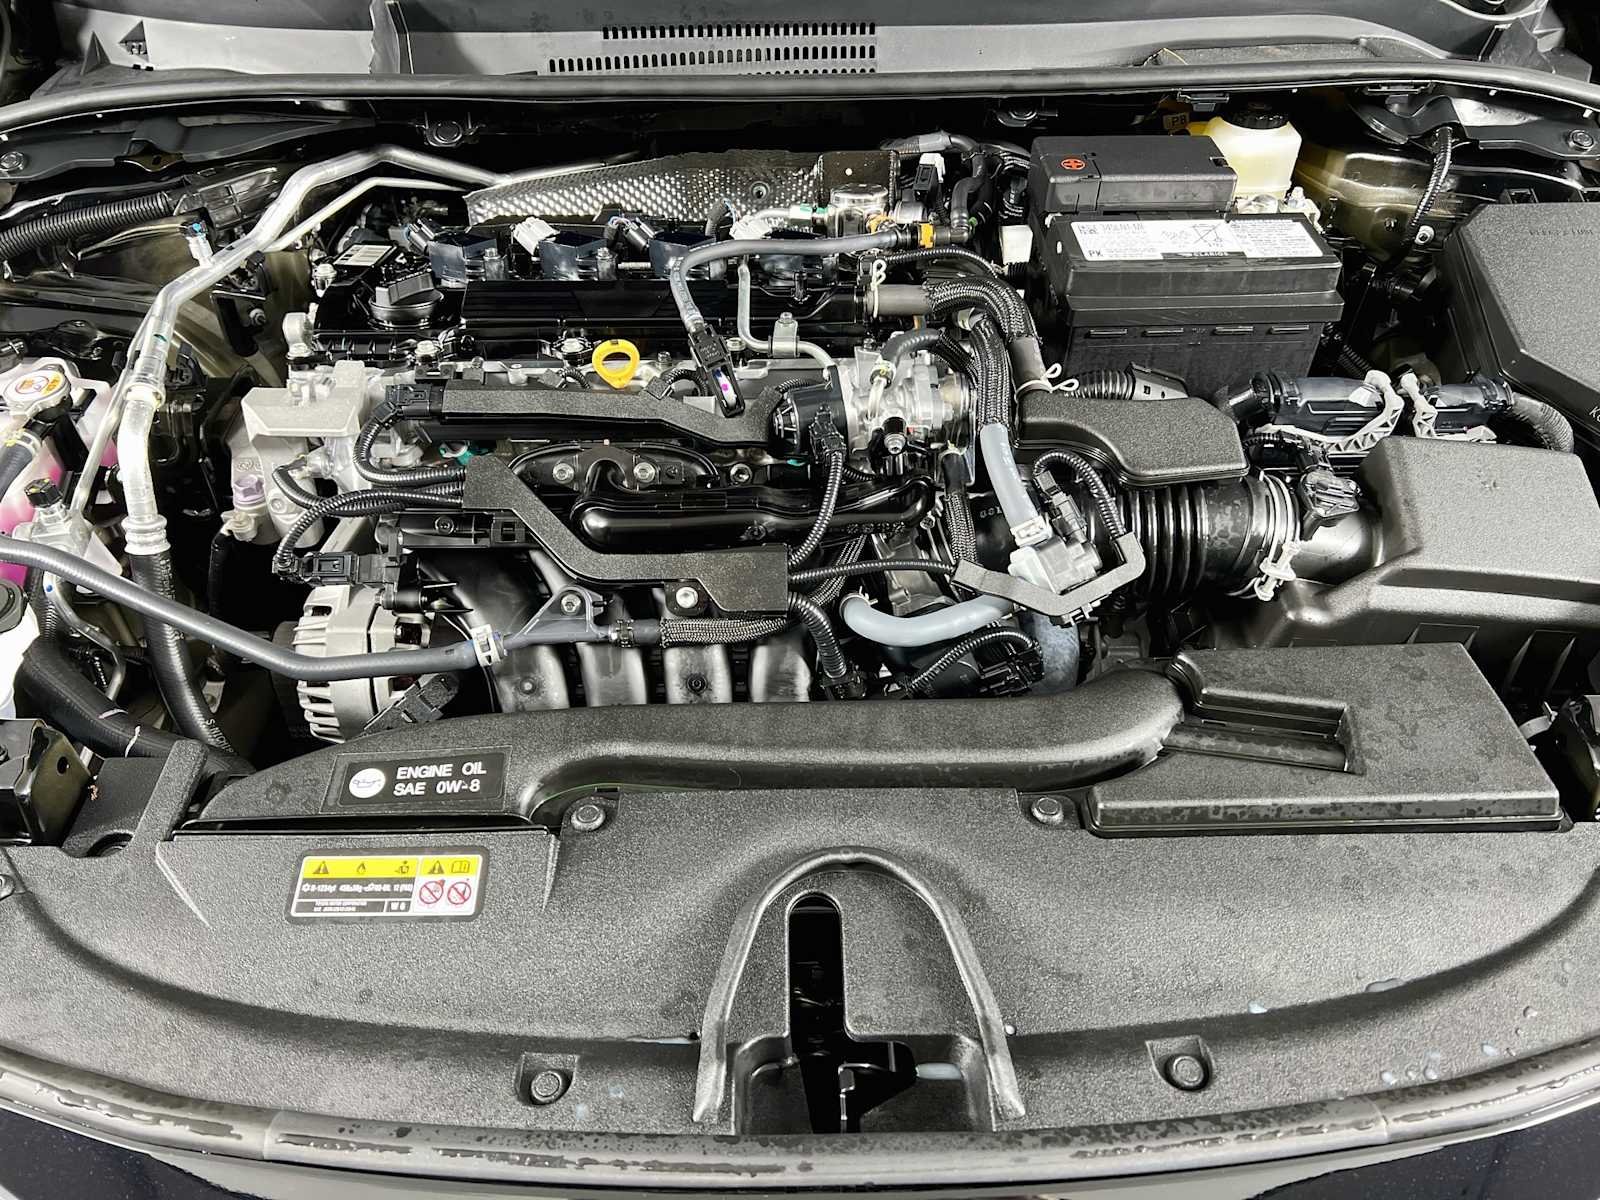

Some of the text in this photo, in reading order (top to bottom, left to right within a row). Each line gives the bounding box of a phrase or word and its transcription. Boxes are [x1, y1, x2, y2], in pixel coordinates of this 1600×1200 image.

[396, 761, 487, 780] ENGINE OIL
[393, 778, 481, 796] SAE 0W-8
